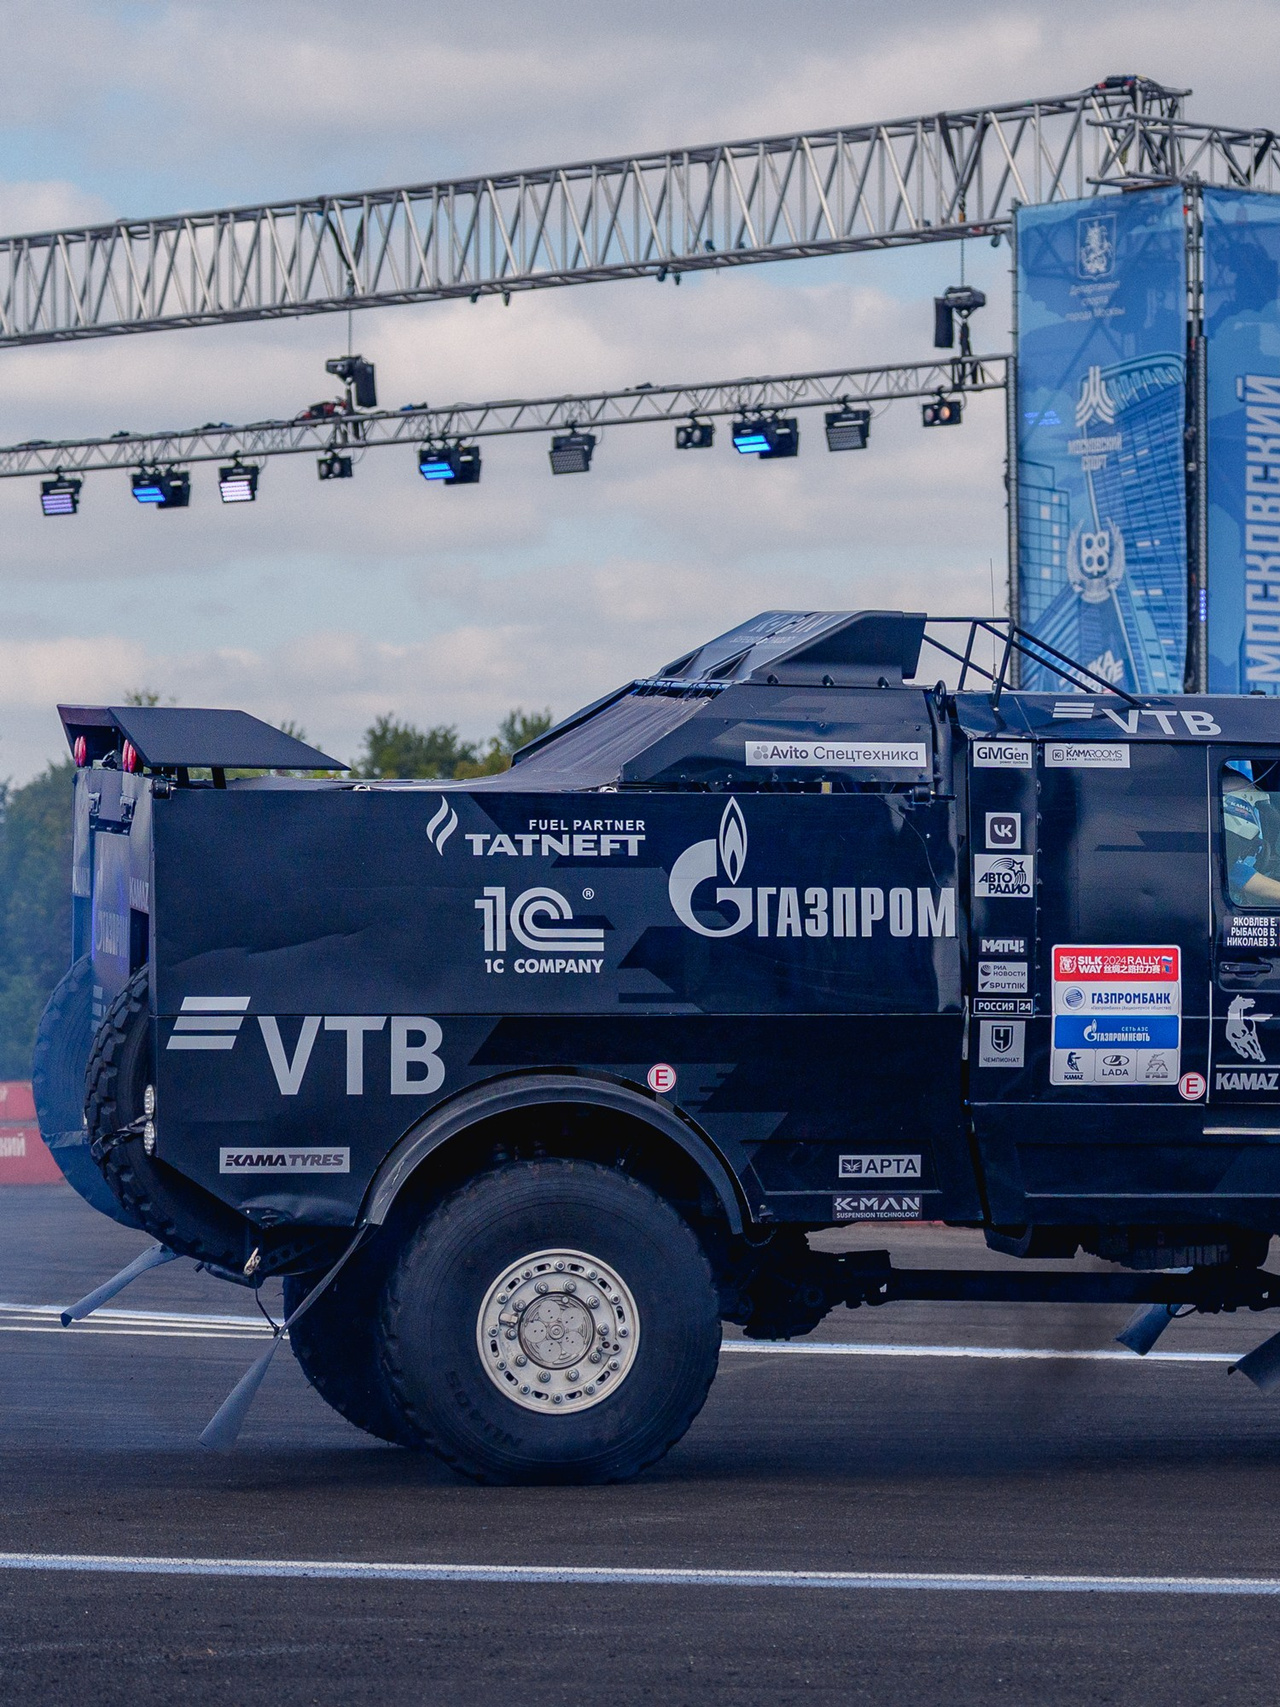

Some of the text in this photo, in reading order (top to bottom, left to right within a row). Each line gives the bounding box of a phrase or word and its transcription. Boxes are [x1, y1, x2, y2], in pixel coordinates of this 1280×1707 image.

[1101, 707, 1222, 736] VTB
[769, 744, 920, 763] Avito Спецтехника
[975, 745, 1030, 762] GMGen
[1066, 747, 1123, 759] KAMAROOMS
[529, 819, 646, 832] FUEL PARTNER
[464, 833, 647, 857] TATNEFT
[979, 872, 1013, 883] АВТО
[988, 883, 1030, 895] РАДИО
[757, 886, 956, 938] ГАЗПРОМ
[1233, 917, 1278, 927] ЯКОВЛЕВ Е.
[1231, 927, 1278, 937] РЫБАКОВ В.
[981, 939, 1025, 953] МАТЧ!
[1226, 937, 1278, 947] НИКОЛАЕВ Э.
[485, 958, 605, 974] 1C COMPANY
[1077, 956, 1160, 965] SILK 2024 RALLY
[1078, 965, 1103, 974] WAY
[1091, 992, 1171, 1004] ГАЗПРОМБАНК
[978, 1002, 1031, 1011] РОССИЯ 24
[257, 1015, 446, 1096] VTB
[654, 1069, 669, 1086] E
[1101, 1068, 1130, 1076] LADA
[1185, 1077, 1199, 1095] E
[1215, 1072, 1279, 1091] KAMAZ
[225, 1153, 345, 1167] KAMA TYRES
[833, 1197, 920, 1211] K-MAN
